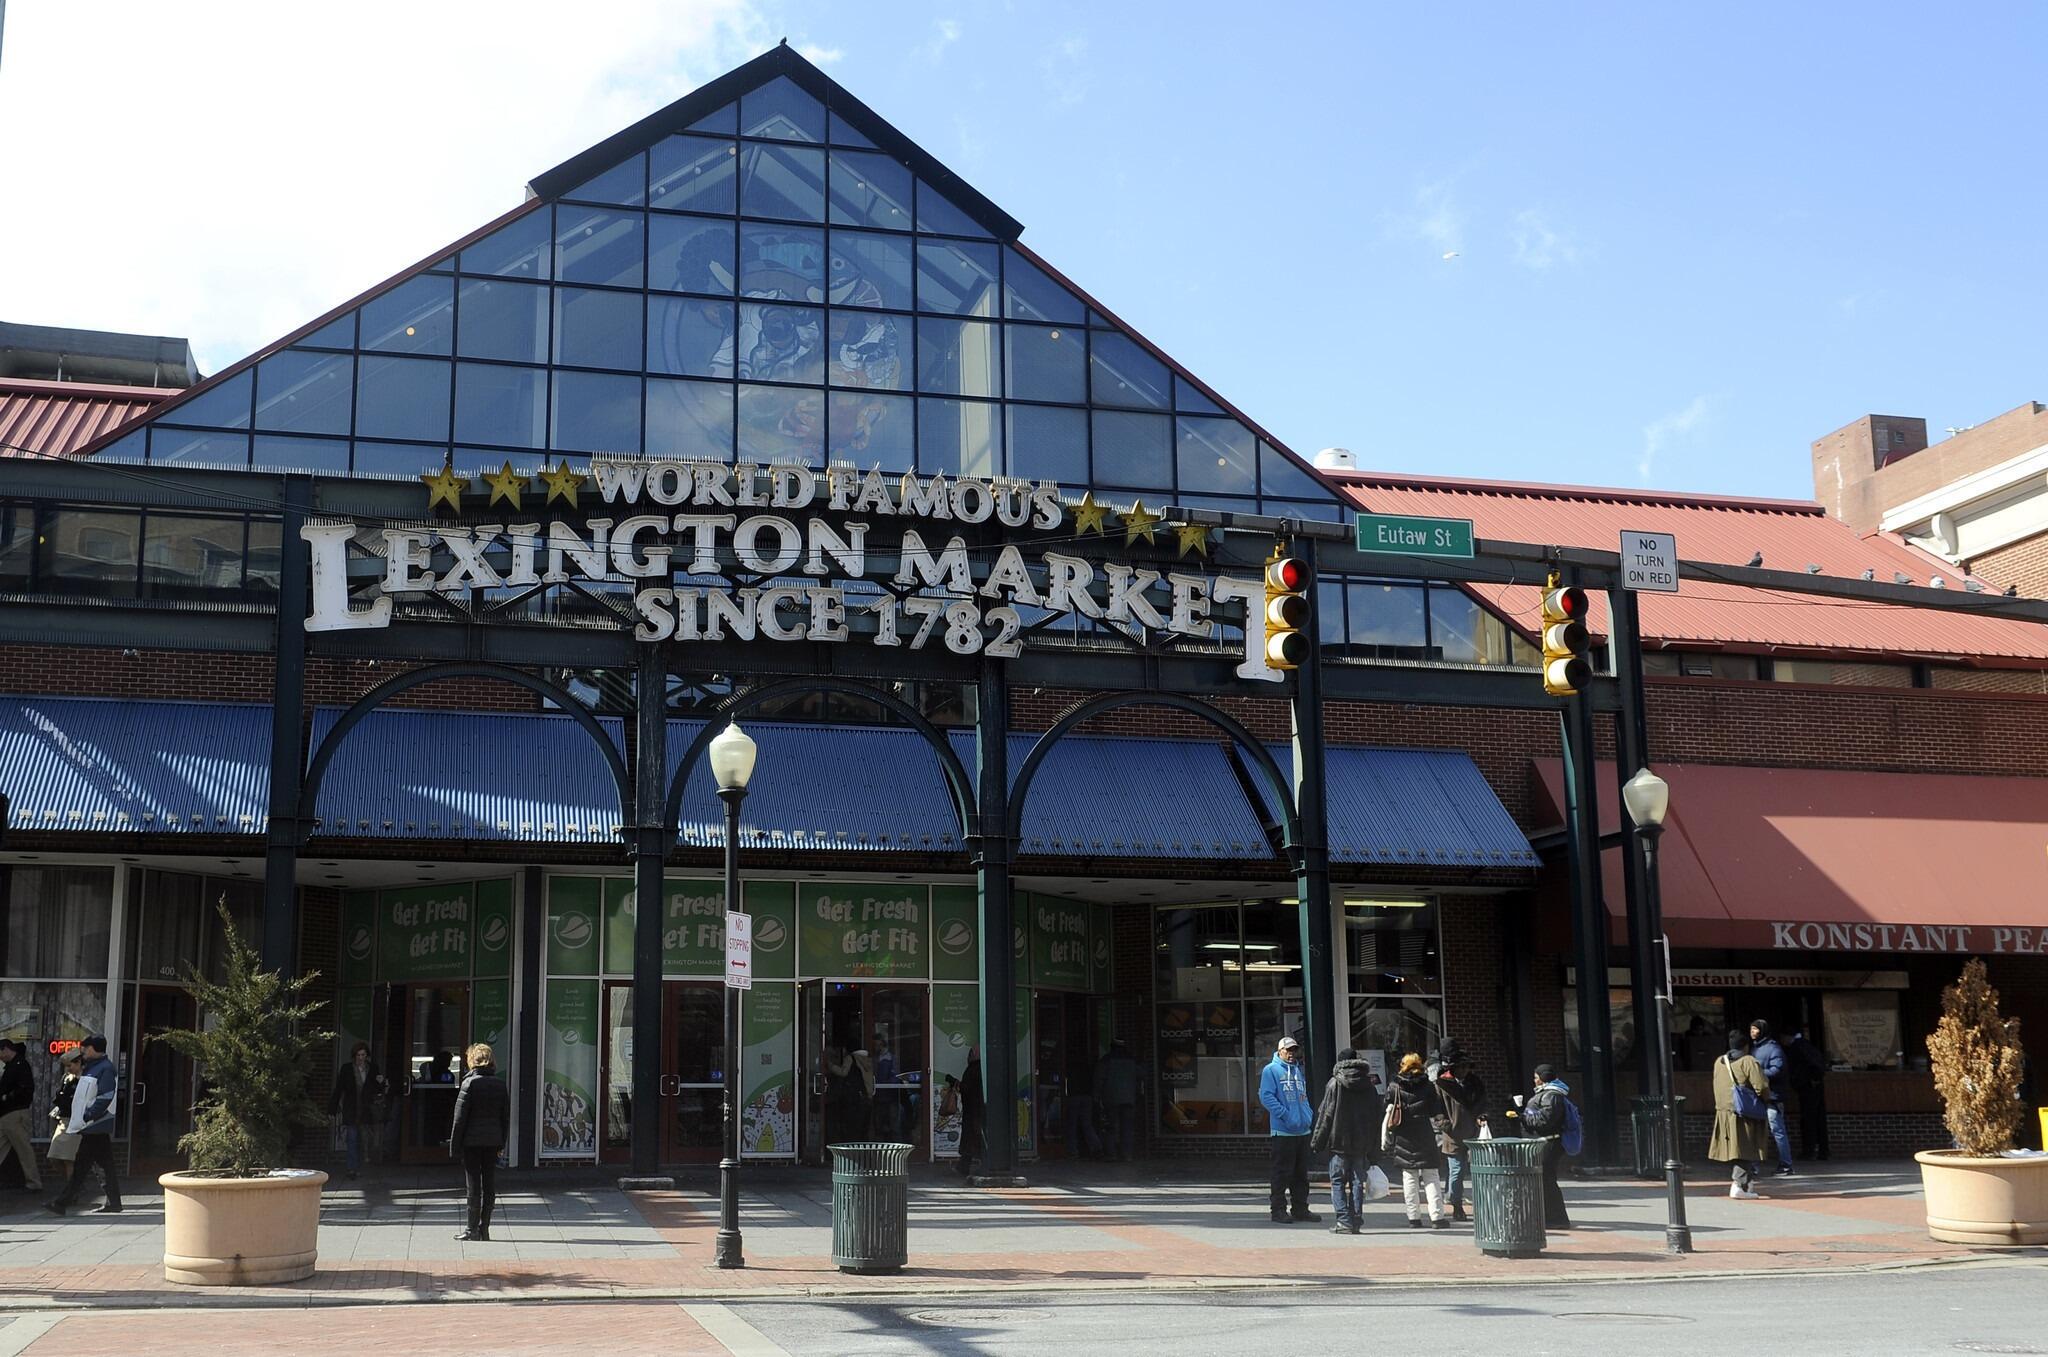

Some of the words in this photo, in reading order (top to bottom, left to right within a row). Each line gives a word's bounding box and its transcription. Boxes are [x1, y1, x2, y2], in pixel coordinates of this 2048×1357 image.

[593, 460, 815, 510] WORLD
[827, 466, 1063, 531] FAMOUS
[1377, 524, 1427, 546] Eutaw
[1434, 528, 1452, 547] St
[1639, 538, 1657, 551] NO
[1634, 554, 1664, 567] TURN
[1629, 570, 1644, 583] ON
[1650, 572, 1672, 584] RED
[300, 513, 870, 632] LEXINGTON
[894, 529, 1285, 683] MARKET
[635, 587, 848, 643] SINCE
[871, 596, 1023, 659] 1782
[392, 901, 420, 927] Get
[424, 896, 468, 924] Fresh
[670, 893, 726, 918] Fresh
[816, 895, 854, 922] Get
[862, 896, 918, 924] Fresh
[735, 918, 744, 932] NO
[1038, 906, 1056, 933] Get
[1059, 911, 1085, 937] Fresh
[409, 930, 438, 958] Get
[443, 927, 466, 954] Fit
[697, 924, 726, 951] Fit
[729, 937, 749, 952] STOPPING
[842, 929, 881, 954] Get
[888, 927, 919, 955] Fit
[1771, 922, 1972, 952] KONSTANT
[1051, 940, 1069, 963] Get
[1071, 940, 1085, 966] Fit
[159, 966, 175, 976] 400
[1669, 973, 1745, 986] onstant
[1751, 971, 1834, 986] Peanuts
[1160, 1029, 1193, 1038] boost
[1206, 1027, 1240, 1037] boost
[49, 1041, 81, 1054] OPEN
[1162, 1072, 1196, 1081] boost
